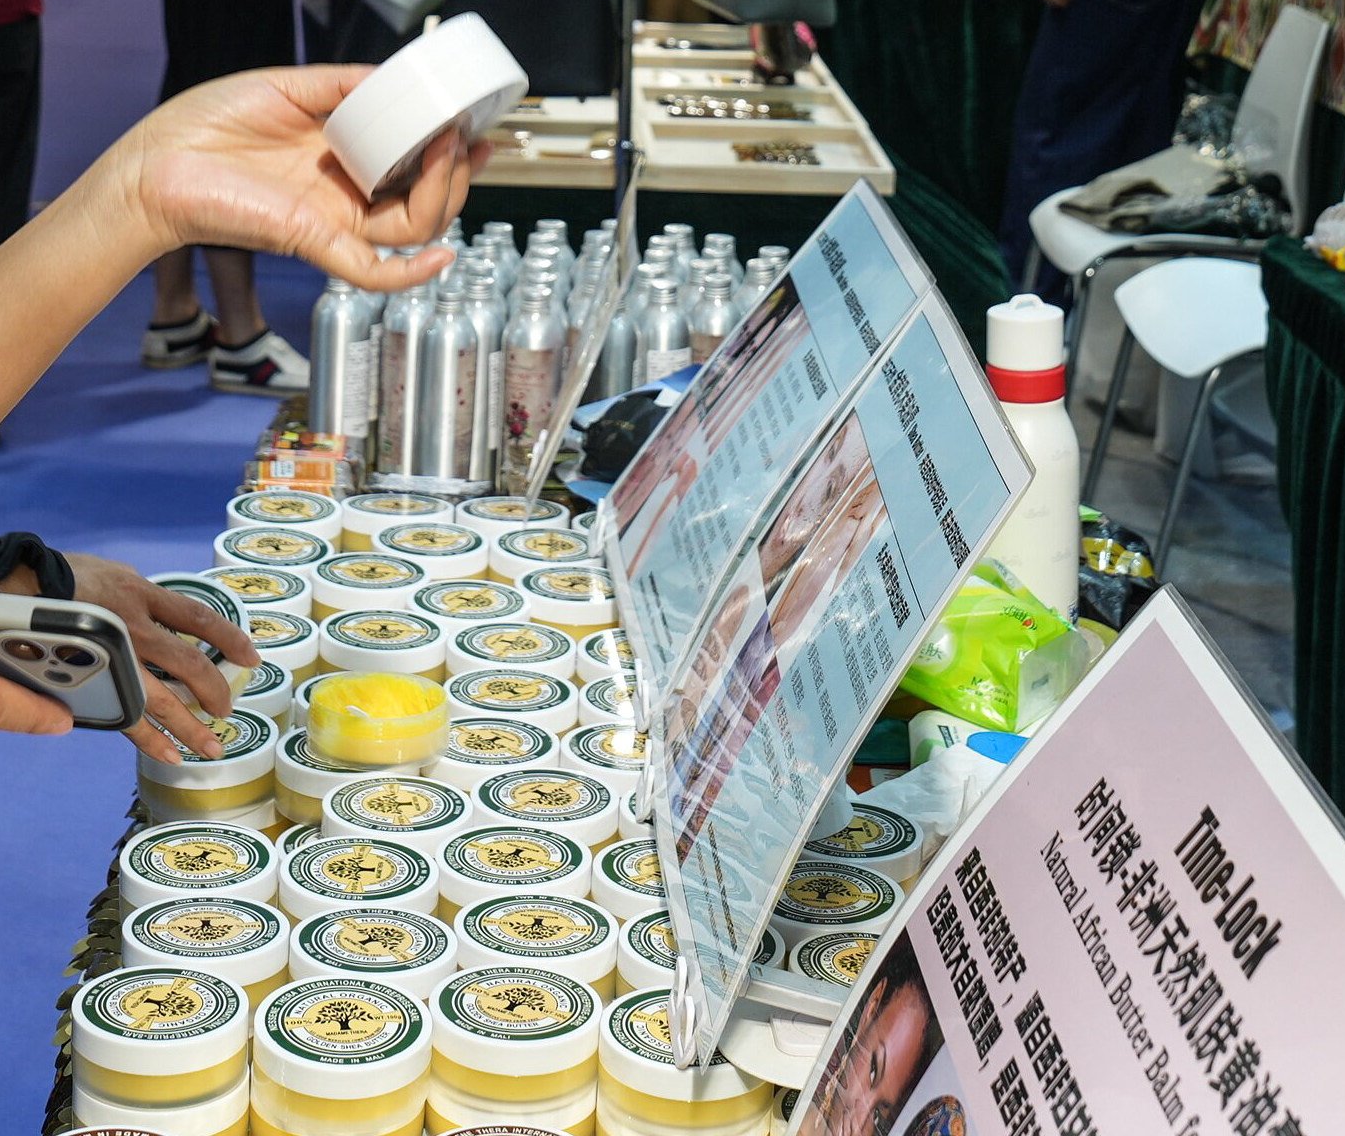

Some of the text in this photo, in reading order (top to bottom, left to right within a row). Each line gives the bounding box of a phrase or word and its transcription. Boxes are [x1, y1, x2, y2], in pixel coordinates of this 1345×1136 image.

[1173, 804, 1283, 981] Time-Lock
[361, 918, 408, 929] NATURAL
[161, 930, 252, 947] NATURAL ORGANIC
[490, 927, 532, 946] ORGANIC
[178, 947, 242, 957] INTERNATIONAL
[347, 954, 377, 962] BUTTER
[501, 946, 568, 957] INTERNATIONAL
[181, 970, 218, 983] NESSENE
[514, 968, 577, 990] INTERNATIONAL
[1040, 829, 1185, 1126] Natural African Butter Balm
[277, 991, 298, 1007] THERA
[299, 979, 366, 993] INTERNATIONAL
[467, 986, 491, 996] 100%
[540, 982, 568, 1009] ORGANIC
[295, 992, 388, 1014] NATURAL ORGANIC
[158, 1012, 207, 1027] ORGANIC
[456, 1019, 474, 1030] MADE
[485, 1018, 504, 1027] SHEA
[306, 1036, 338, 1050] GOLDEN
[365, 1031, 390, 1047] BUTTER
[636, 1024, 671, 1050] ORGANIC
[320, 1056, 344, 1064] MADE
[365, 1053, 385, 1062] MALI
[475, 1127, 508, 1135] THERA
